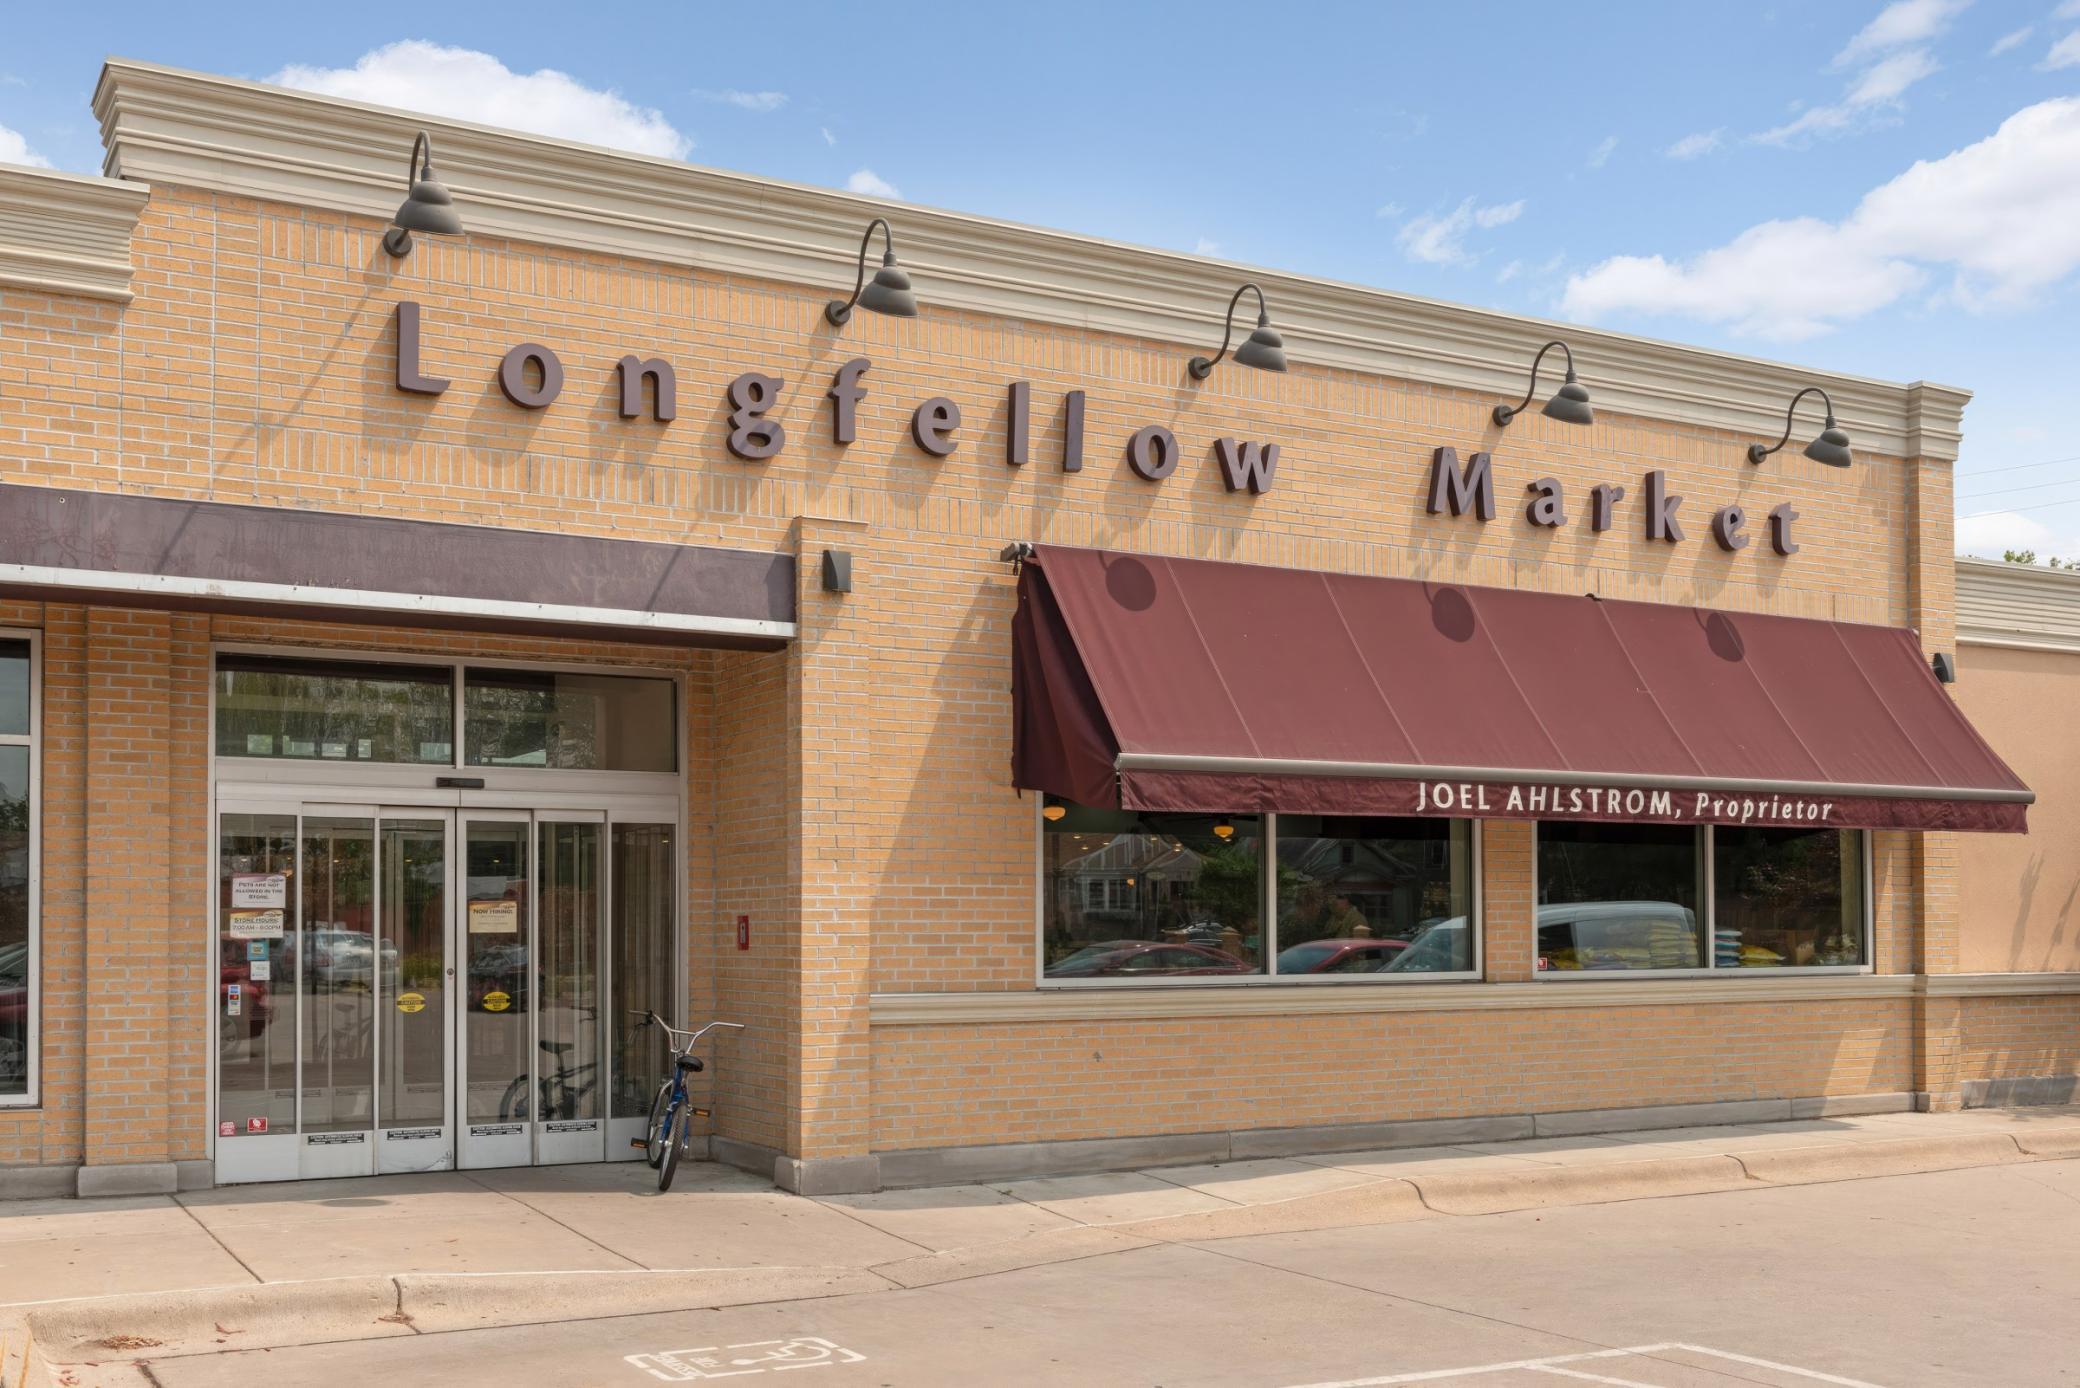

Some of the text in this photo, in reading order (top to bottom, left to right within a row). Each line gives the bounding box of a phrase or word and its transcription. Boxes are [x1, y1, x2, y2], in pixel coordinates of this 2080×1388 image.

[396, 301, 1799, 557] Longfellow Market
[1416, 781, 1834, 824] JOEL AHLSTROM, Proprietor
